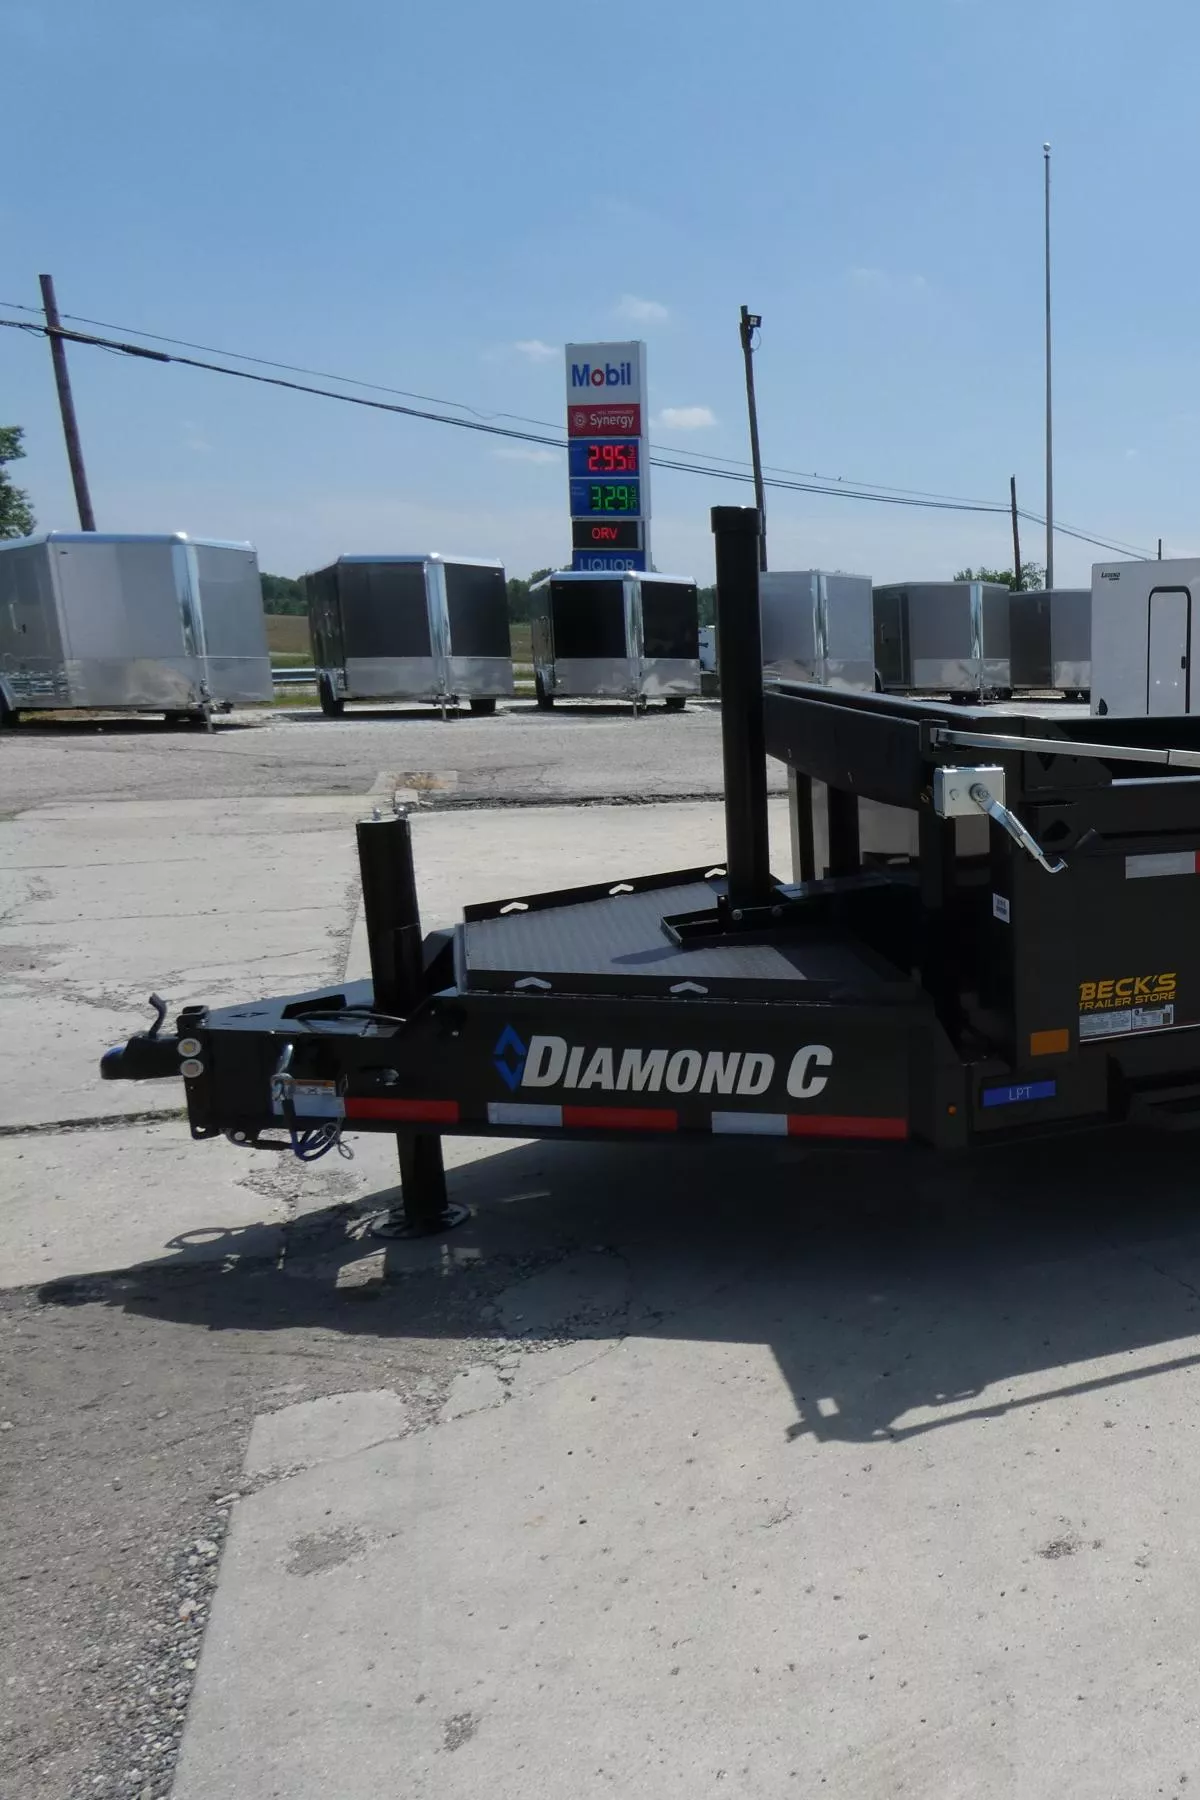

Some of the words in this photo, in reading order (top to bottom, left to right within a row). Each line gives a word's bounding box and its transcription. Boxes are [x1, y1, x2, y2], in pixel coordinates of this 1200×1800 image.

[572, 363, 631, 387] Mobil
[590, 413, 634, 428] Synergy
[591, 527, 618, 540] ORV
[580, 557, 634, 571] LIQUOR
[1080, 973, 1176, 1001] BECK'S
[1079, 997, 1132, 1011] TRAILER
[1135, 991, 1176, 1004] STORE
[521, 1035, 775, 1095] DIAMOND
[786, 1044, 833, 1098] C
[1008, 1086, 1032, 1101] LPT
